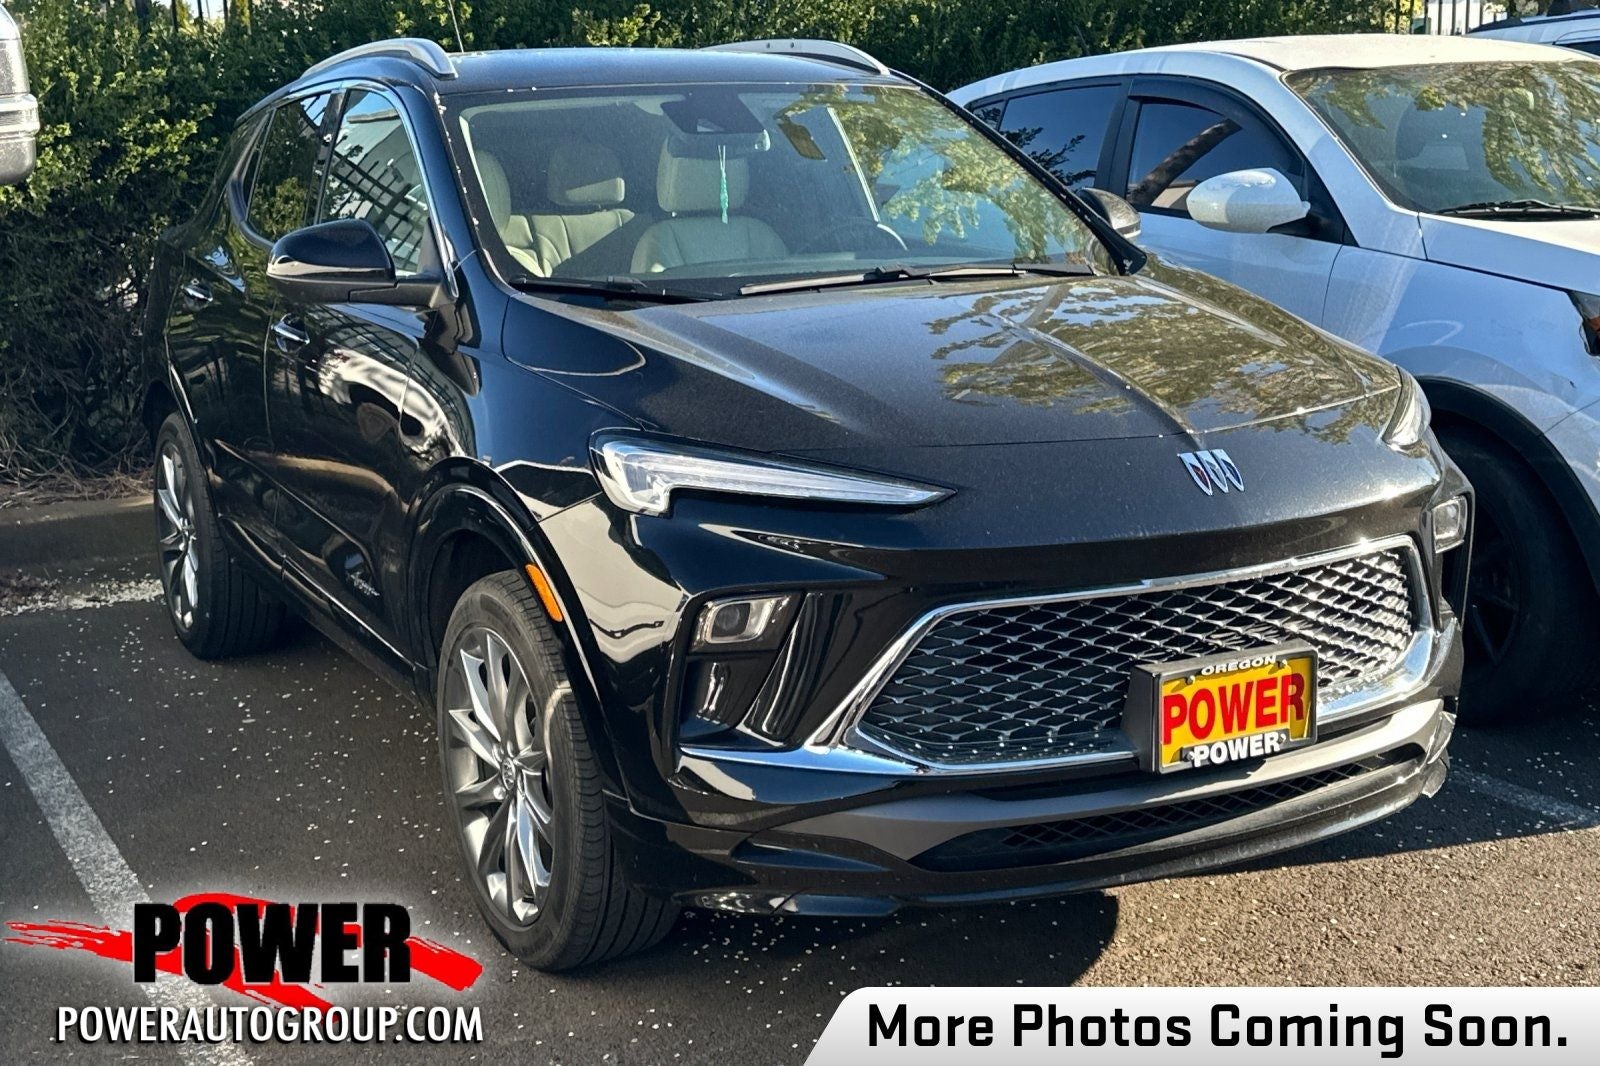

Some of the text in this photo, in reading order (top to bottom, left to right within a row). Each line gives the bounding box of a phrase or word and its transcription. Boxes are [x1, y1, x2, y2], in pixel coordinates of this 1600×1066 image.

[1201, 655, 1277, 676] OREGON
[1161, 672, 1305, 746] POWER
[1192, 732, 1281, 768] POWER
